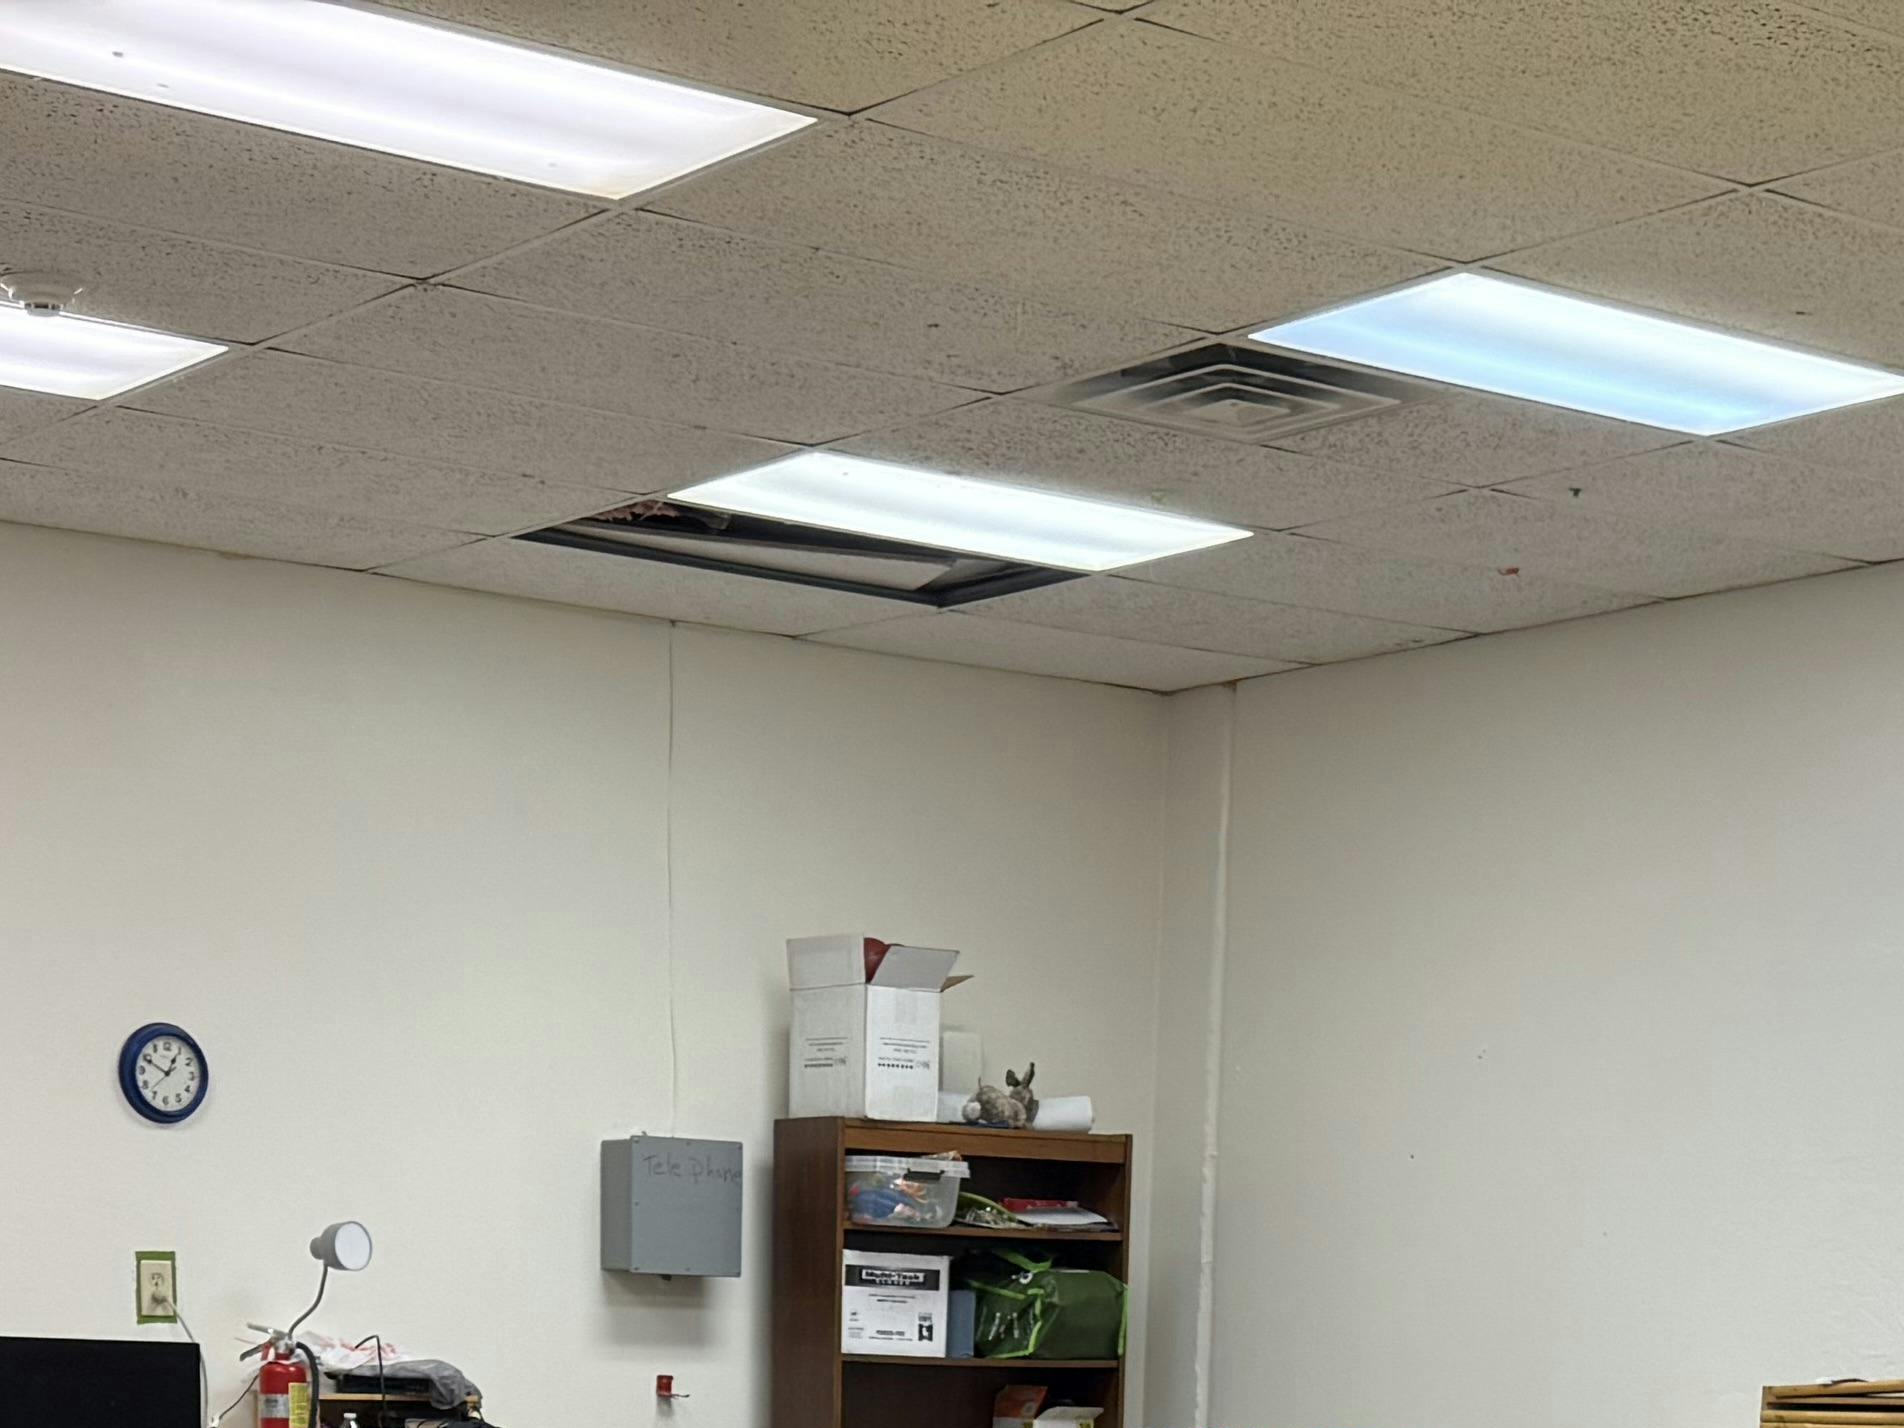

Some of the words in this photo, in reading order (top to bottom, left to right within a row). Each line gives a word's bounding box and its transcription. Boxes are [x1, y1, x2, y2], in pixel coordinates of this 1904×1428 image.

[163, 1041, 172, 1052] 12
[185, 1057, 193, 1067] 2
[184, 1084, 191, 1093] 4
[175, 1093, 182, 1103] 5
[864, 1271, 920, 1280] Multi-Task
